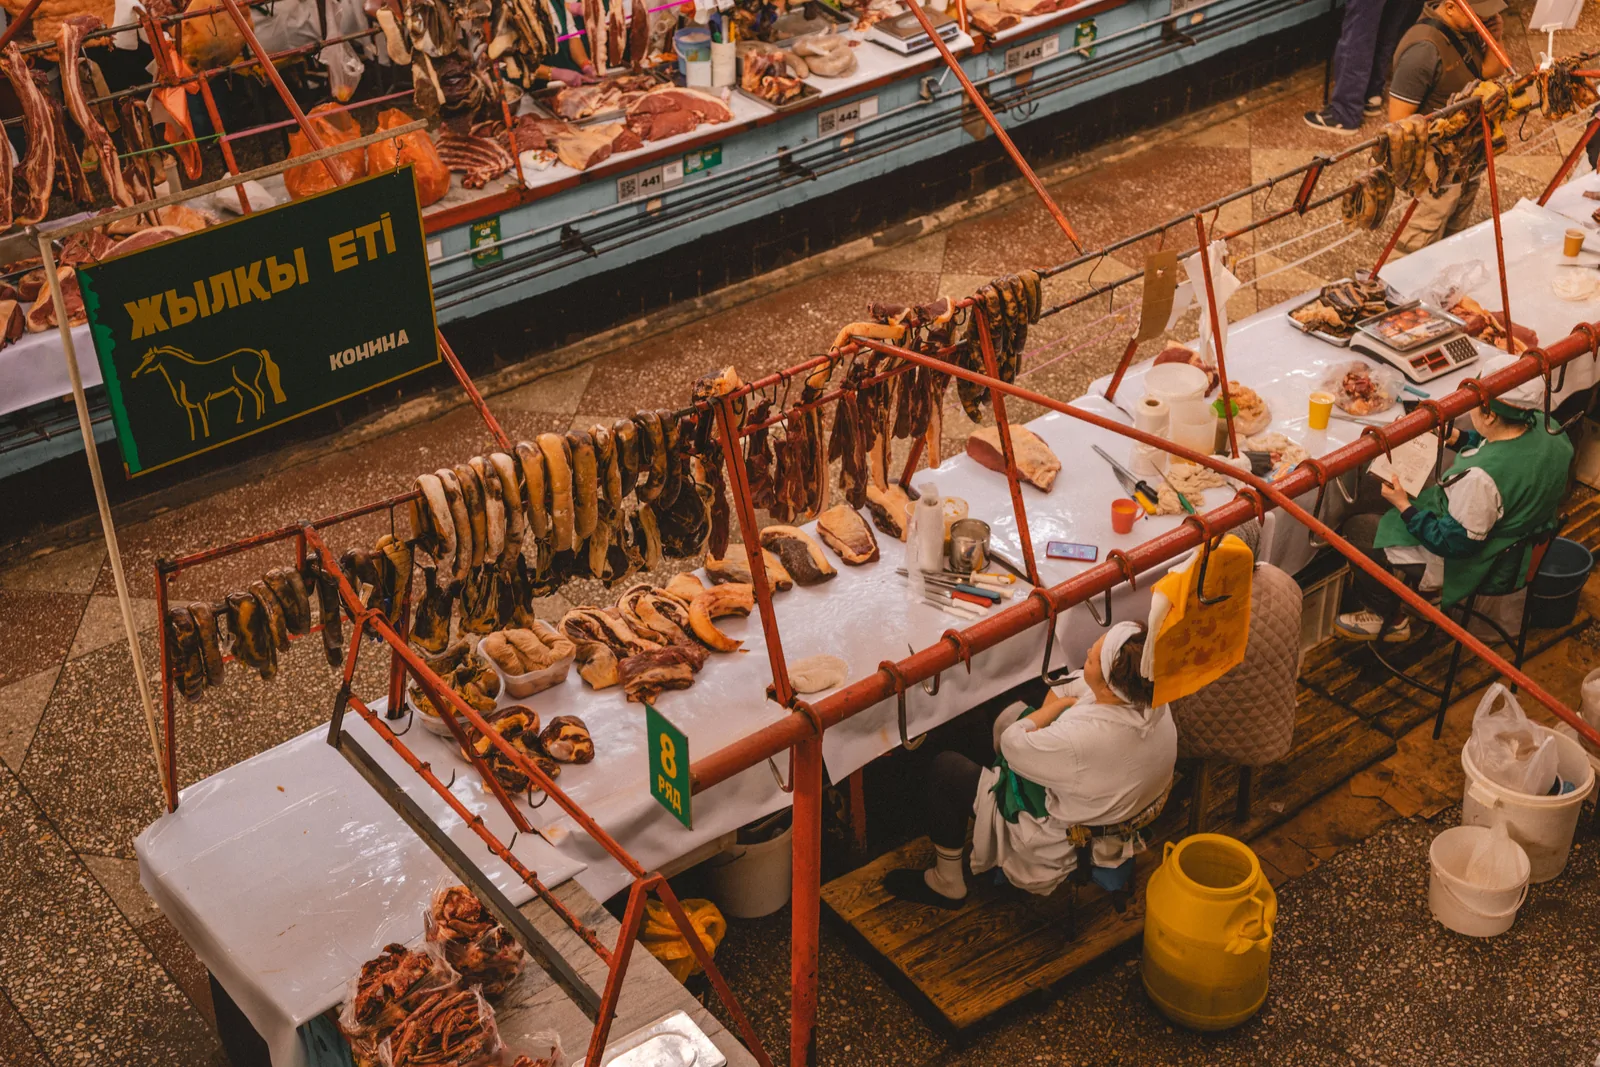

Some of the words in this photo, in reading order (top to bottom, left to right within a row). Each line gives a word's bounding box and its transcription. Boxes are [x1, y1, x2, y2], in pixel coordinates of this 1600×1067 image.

[839, 110, 858, 122] 442
[641, 175, 660, 188] 441
[123, 247, 309, 341] ЖЫЛҚЫ
[329, 329, 409, 371] КОНИНА
[660, 733, 677, 779] 8
[658, 774, 682, 815] РЯД
